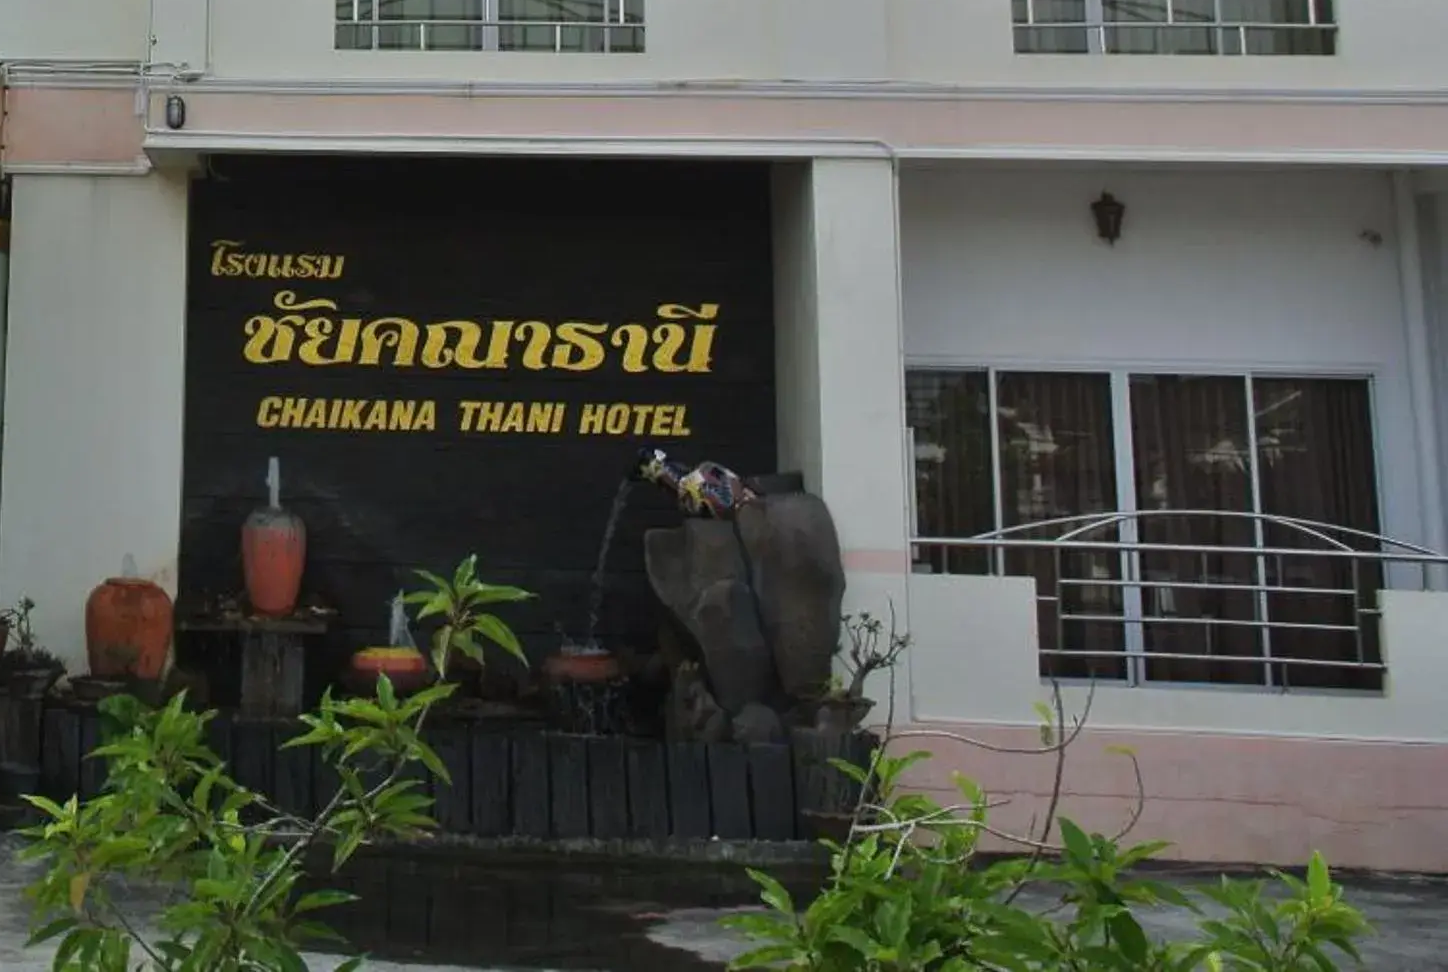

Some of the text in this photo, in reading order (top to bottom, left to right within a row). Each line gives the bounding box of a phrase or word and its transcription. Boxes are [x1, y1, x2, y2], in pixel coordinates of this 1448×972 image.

[210, 239, 345, 279] โรงแรม
[243, 290, 720, 373] ชัยคณาธานี
[257, 397, 691, 436] CHAIKANA THANI HOTEL
